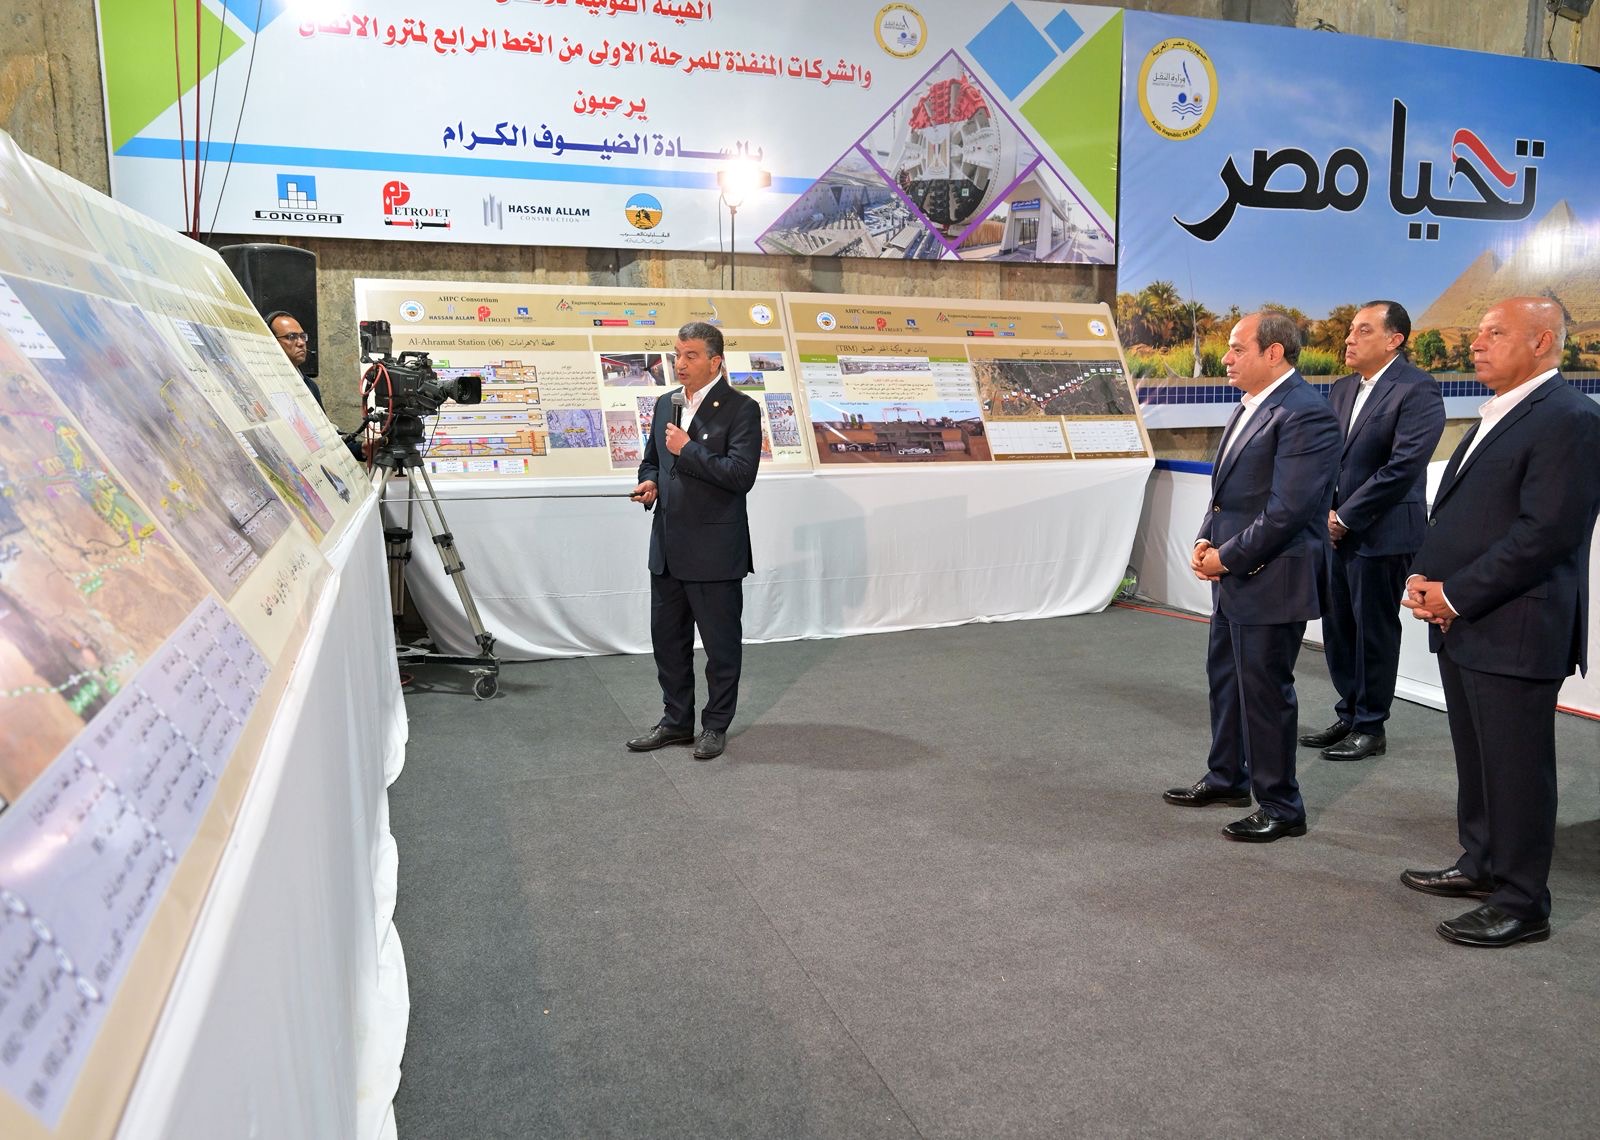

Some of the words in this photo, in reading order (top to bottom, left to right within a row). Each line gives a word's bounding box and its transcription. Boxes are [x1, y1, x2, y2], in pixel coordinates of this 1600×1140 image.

[384, 18, 427, 45] لمترو
[433, 26, 496, 54] الرابع
[502, 29, 552, 54] الخط
[558, 37, 583, 62] من
[588, 40, 643, 66] الاولى
[649, 41, 720, 73] للمرحلة
[725, 51, 782, 76] المنفذة
[787, 57, 872, 89] والشركات
[573, 90, 648, 121] يرحبون
[443, 121, 527, 150] الكرام
[1151, 120, 1161, 131] Arab
[1162, 127, 1181, 138] Republic
[1189, 123, 1202, 135] Egypt
[533, 124, 648, 161] الضيوف
[1390, 98, 1545, 241] تحيا
[383, 181, 451, 218] PETROJET
[1173, 148, 1369, 242] مصر
[508, 204, 551, 215] HASSAN
[555, 208, 590, 217] ALLAM
[520, 215, 580, 223] CONSTRUCTION
[461, 296, 499, 304] Consortium
[408, 338, 456, 347] Al-Ahramat
[458, 338, 486, 346] Station
[488, 338, 504, 347] (06)
[836, 344, 858, 353] (TBM)
